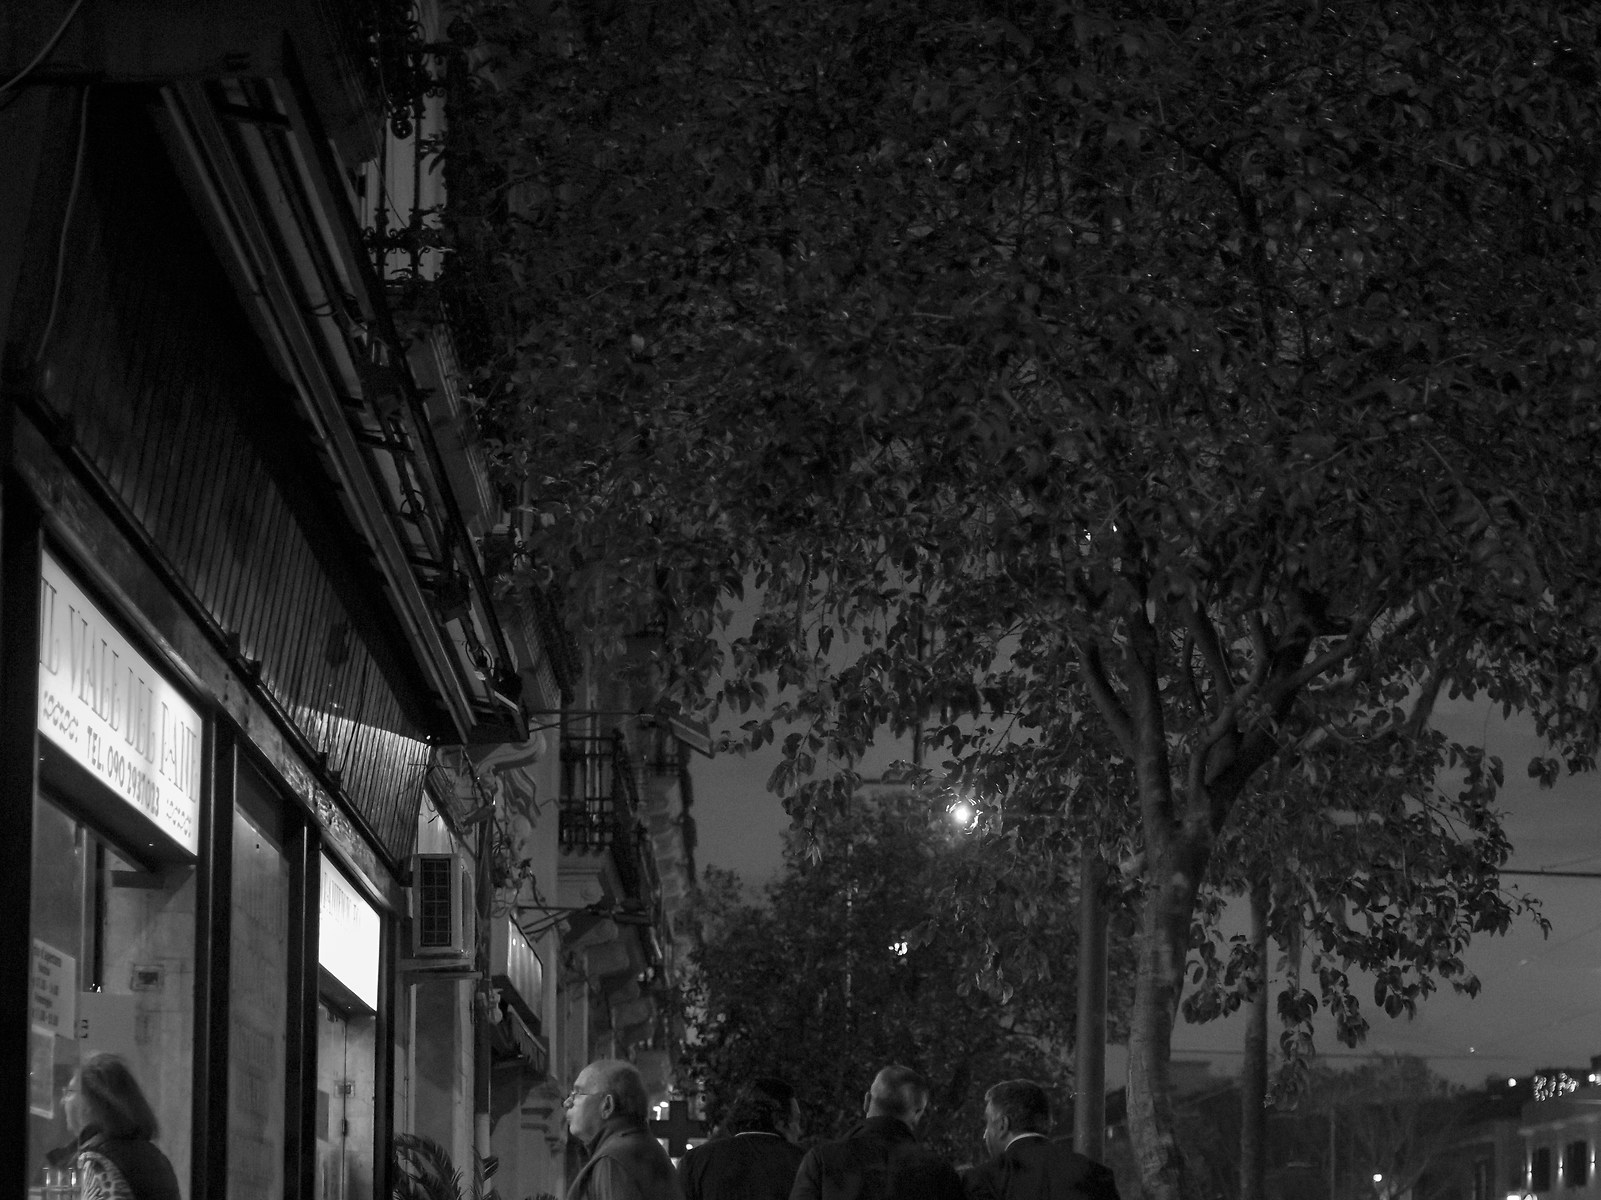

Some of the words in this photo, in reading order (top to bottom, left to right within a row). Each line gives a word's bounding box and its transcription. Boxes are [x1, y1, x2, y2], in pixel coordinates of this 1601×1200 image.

[68, 604, 121, 733] VIALE
[124, 666, 156, 764] DEL
[159, 701, 197, 804] PANE
[87, 725, 104, 772] TEL.
[107, 745, 125, 788] 090
